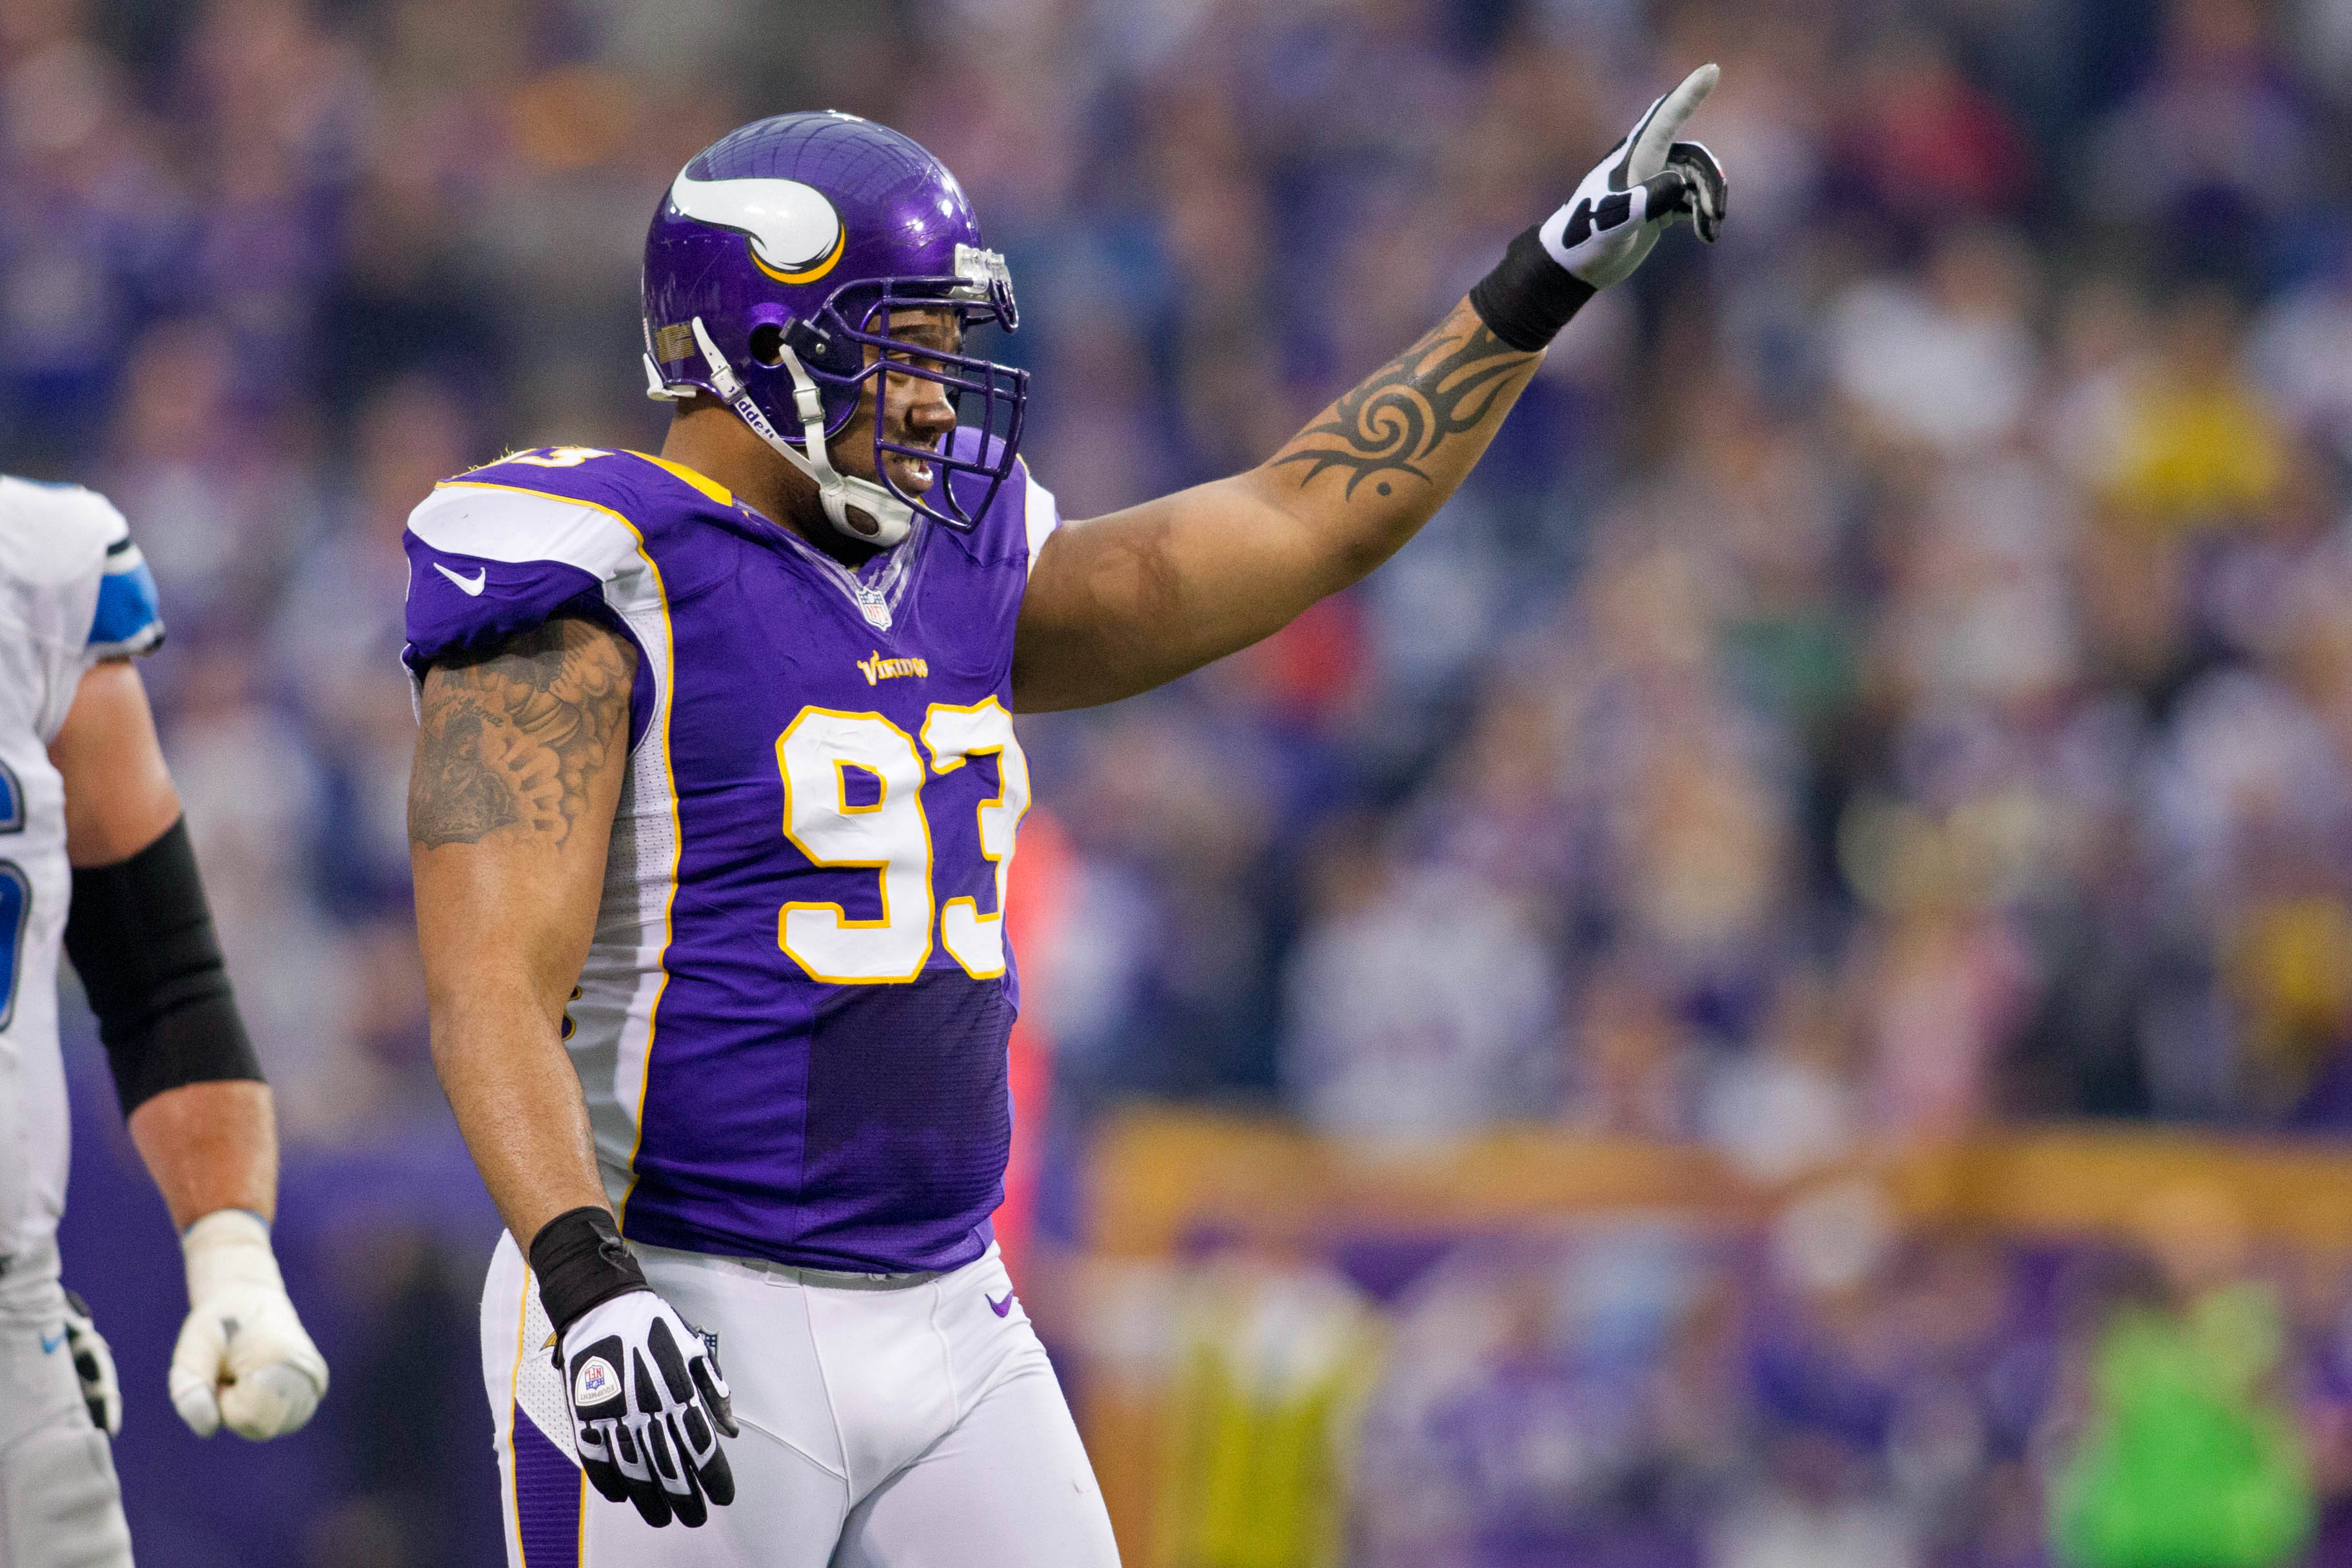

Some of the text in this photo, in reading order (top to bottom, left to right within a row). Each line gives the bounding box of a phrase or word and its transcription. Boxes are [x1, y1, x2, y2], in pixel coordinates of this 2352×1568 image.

[775, 694, 1032, 985] 93
[587, 1367, 602, 1380] NFL
[580, 1384, 615, 1400] EQUIPMENT
